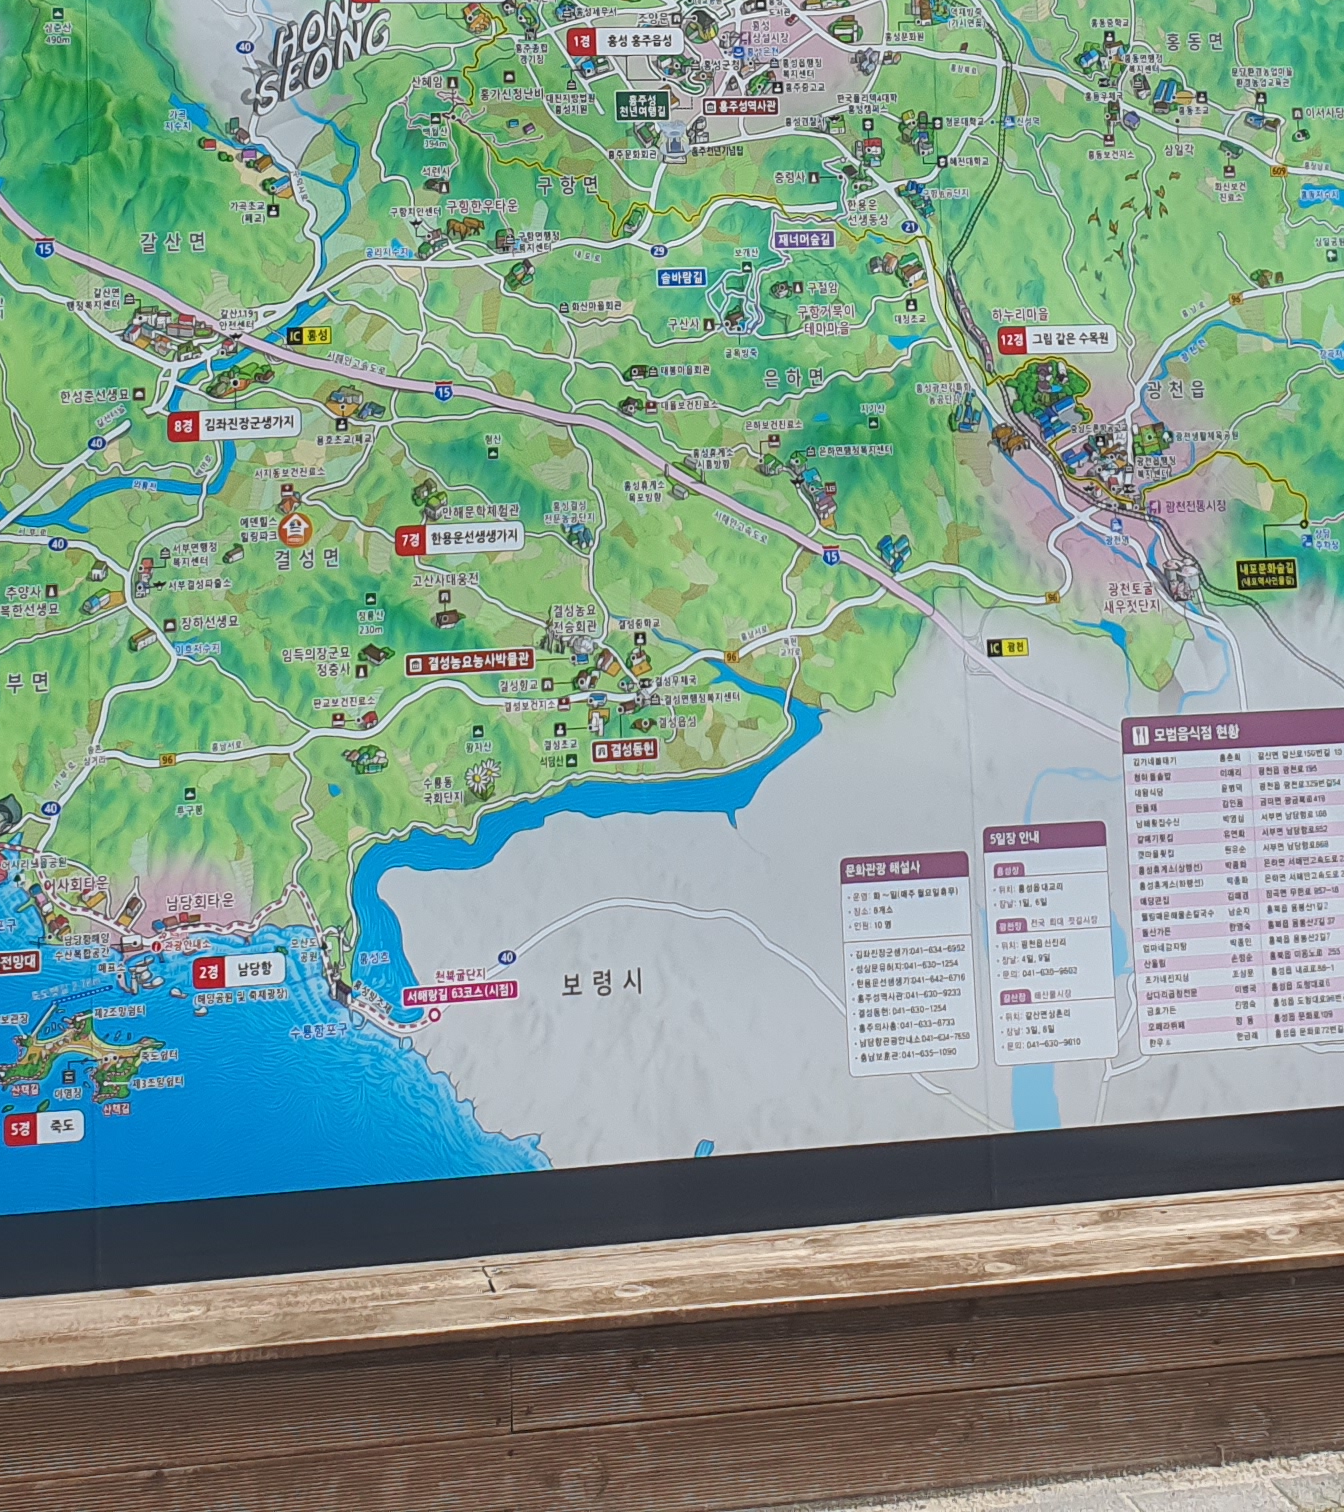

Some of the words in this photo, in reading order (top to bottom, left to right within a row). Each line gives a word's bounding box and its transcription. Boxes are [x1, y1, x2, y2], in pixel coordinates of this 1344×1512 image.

[572, 33, 591, 50] 1경
[608, 33, 627, 49] 홍성
[254, 9, 391, 116] SEONG
[719, 99, 776, 114] 홍주성역사관
[778, 233, 831, 248] 재너머숲길
[37, 243, 53, 256] 15
[661, 271, 703, 285] 솔바람길
[288, 329, 300, 343] IC
[306, 328, 328, 343] 홍성
[1000, 332, 1023, 347] 12경
[1031, 331, 1052, 347] 그림
[1055, 332, 1075, 346] 같은
[1078, 331, 1109, 346] 수목원
[61, 390, 130, 403] 한성준선생묘
[174, 417, 194, 435] 8경
[205, 414, 294, 434] 김좌진장군생가지
[402, 532, 420, 549] 7경
[431, 528, 518, 546] 한용운선생생가지
[6, 585, 42, 600] 추양사
[989, 641, 1000, 655] IC
[1007, 640, 1025, 653] 광천
[428, 651, 529, 671] 결성농요농사박물관
[1154, 724, 1212, 742] 모범음식점
[1216, 724, 1240, 740] 현황
[610, 740, 655, 759] 결성동헌
[161, 753, 173, 765] 96
[990, 831, 1016, 845] 5일장
[1019, 830, 1040, 844] 안내
[846, 861, 886, 876] 문화관광
[889, 859, 920, 874] 해설사
[167, 893, 234, 911] 남당회타운
[199, 964, 219, 981] 2경
[237, 961, 272, 977] 남당항
[10, 1119, 31, 1136] 5경
[51, 1118, 75, 1134] 죽도
